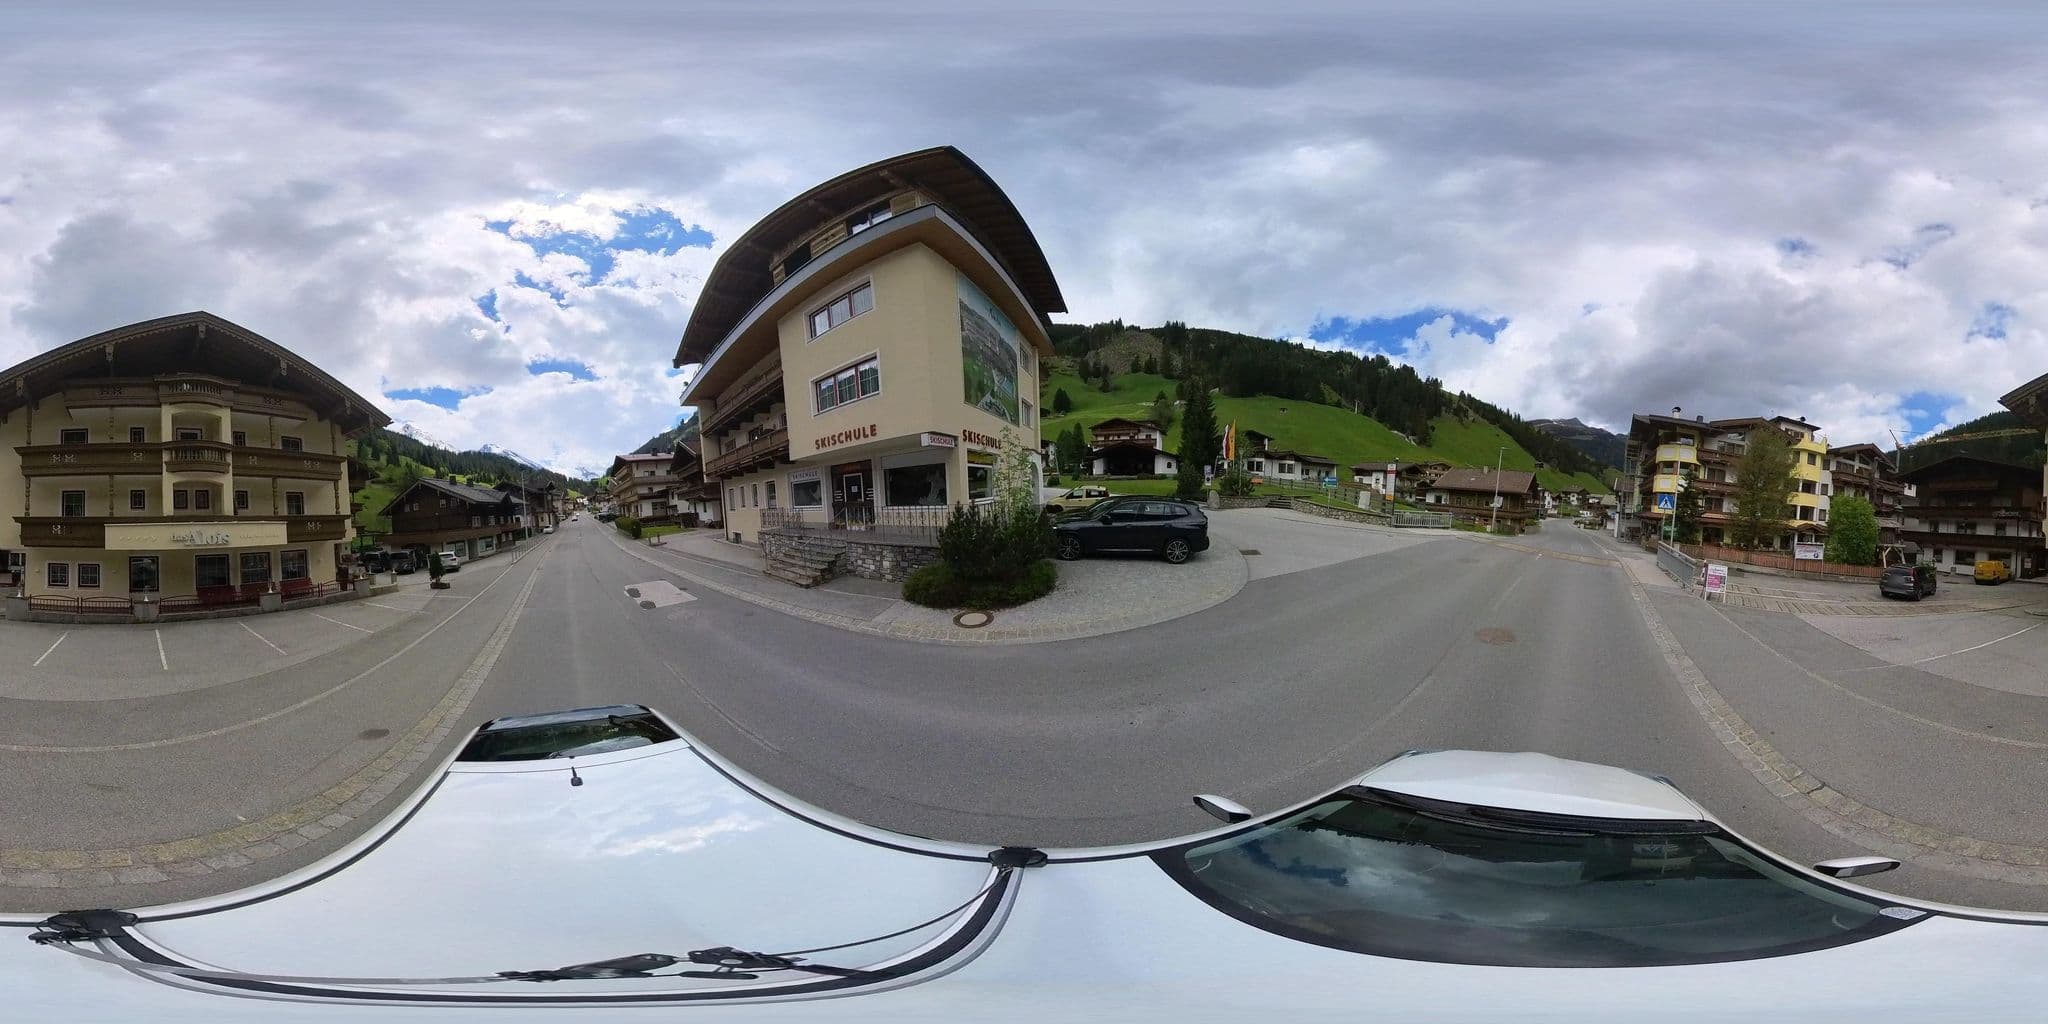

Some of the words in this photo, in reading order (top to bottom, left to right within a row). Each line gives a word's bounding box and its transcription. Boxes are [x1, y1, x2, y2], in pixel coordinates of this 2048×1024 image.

[815, 424, 877, 450] SKISCHULE
[929, 435, 953, 446] SKISCHULE
[962, 429, 1002, 450] SKISCHULE
